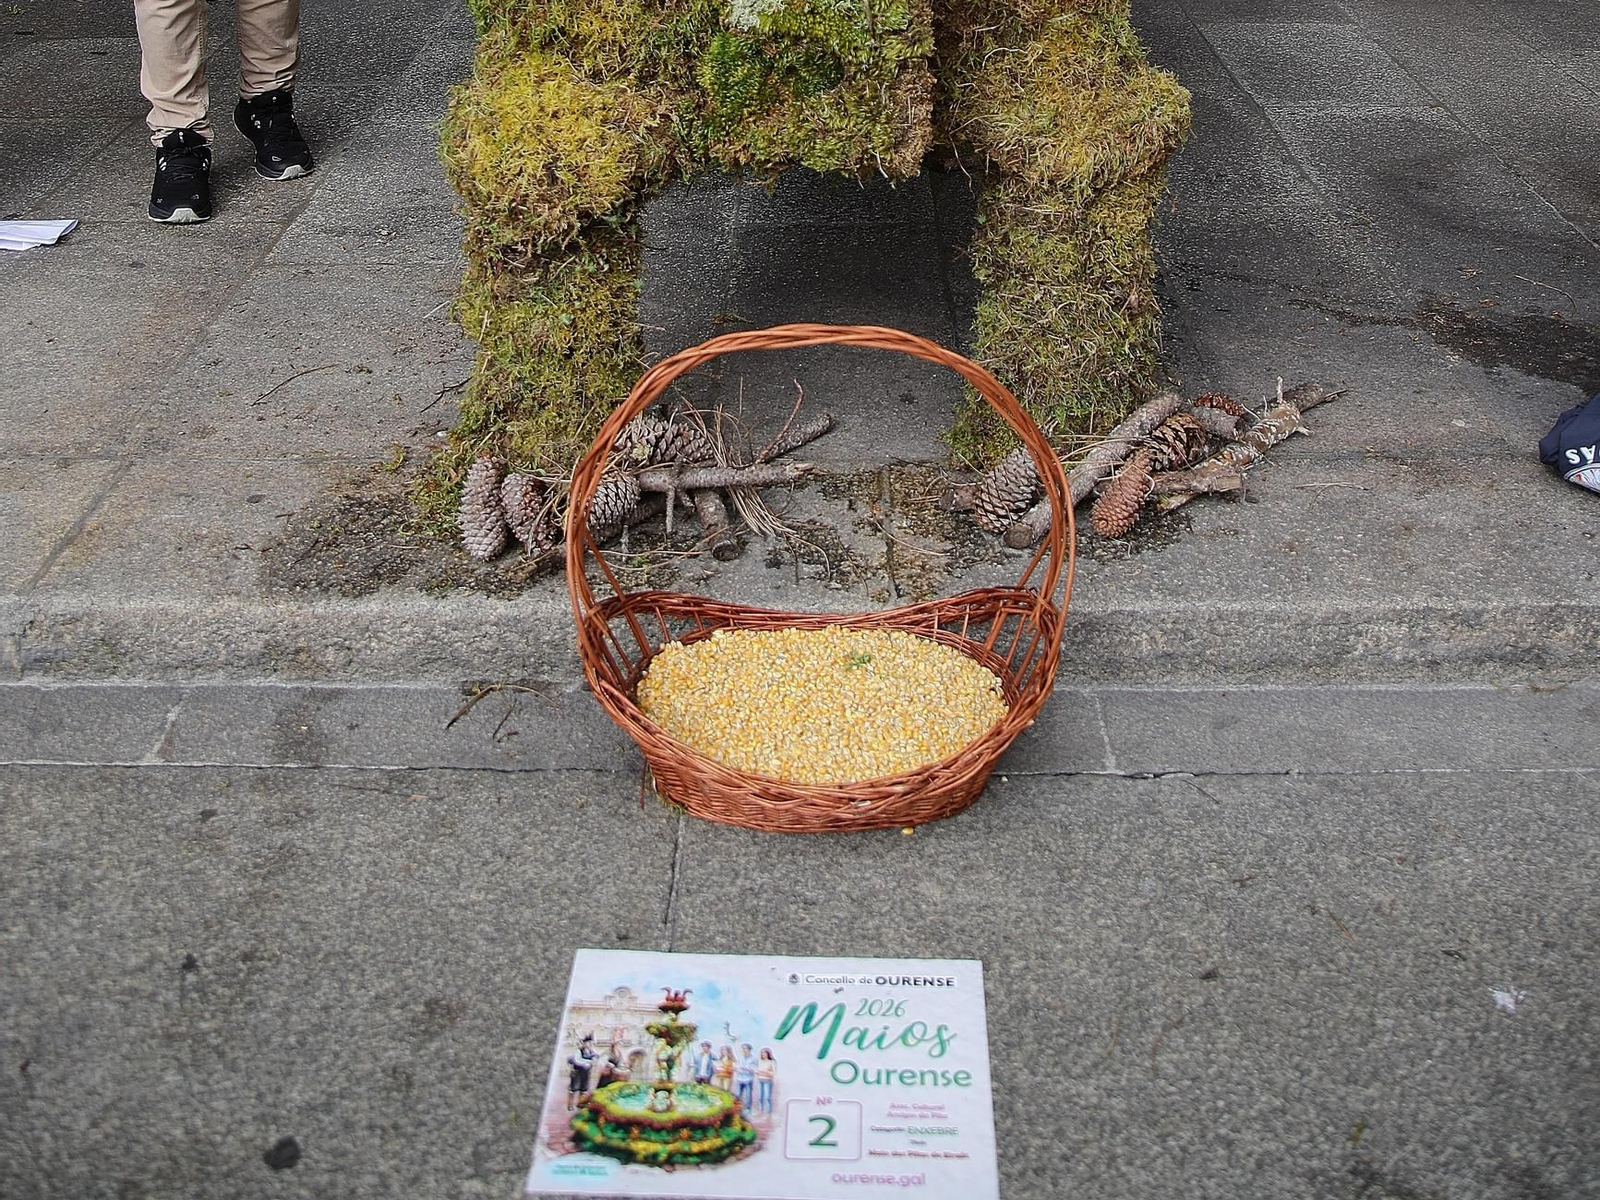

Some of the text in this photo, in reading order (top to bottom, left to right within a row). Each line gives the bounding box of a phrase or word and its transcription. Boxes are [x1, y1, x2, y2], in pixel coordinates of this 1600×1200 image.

[805, 974, 956, 987] Concello de OURENSE
[854, 998, 909, 1017] 2026
[774, 1001, 957, 1059] Maios
[830, 1060, 972, 1086] Ourense
[808, 1115, 839, 1147] 2
[907, 1125, 960, 1135] ENXEBRE
[831, 1172, 926, 1187] ourense.gal
